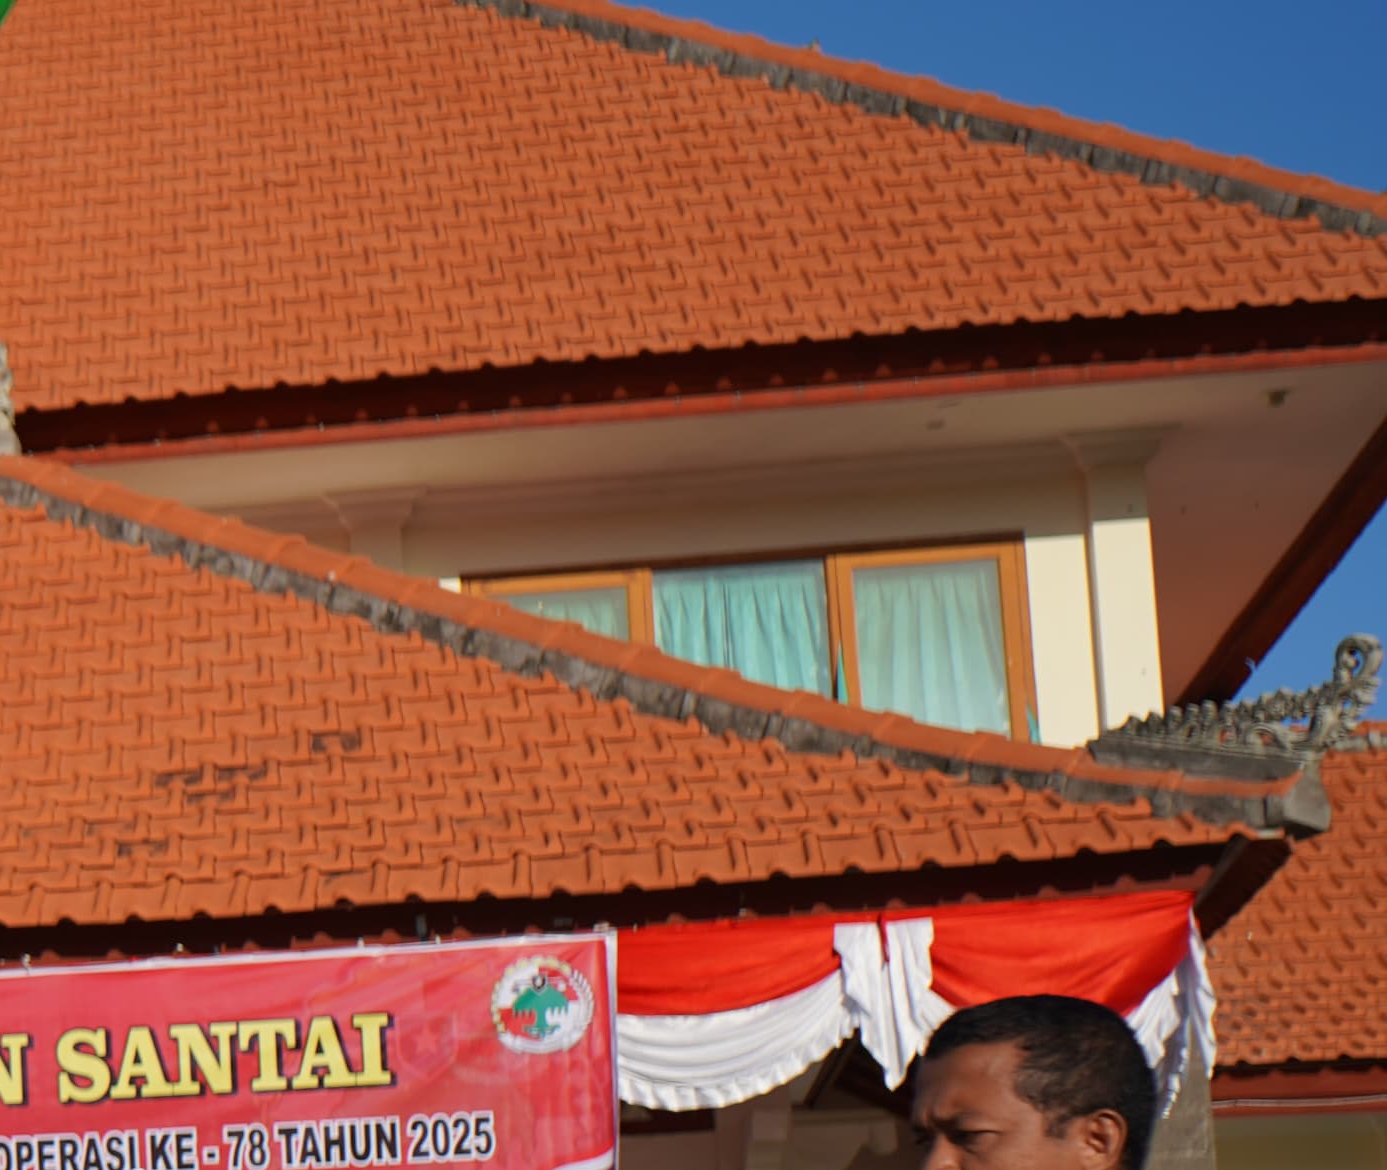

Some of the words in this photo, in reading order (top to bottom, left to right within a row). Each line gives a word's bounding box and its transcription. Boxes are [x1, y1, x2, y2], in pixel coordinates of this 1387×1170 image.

[56, 1011, 395, 1105] SANTAI
[229, 1130, 267, 1169] 78
[277, 1122, 399, 1164] TAHUN
[410, 1116, 493, 1159] 2025
